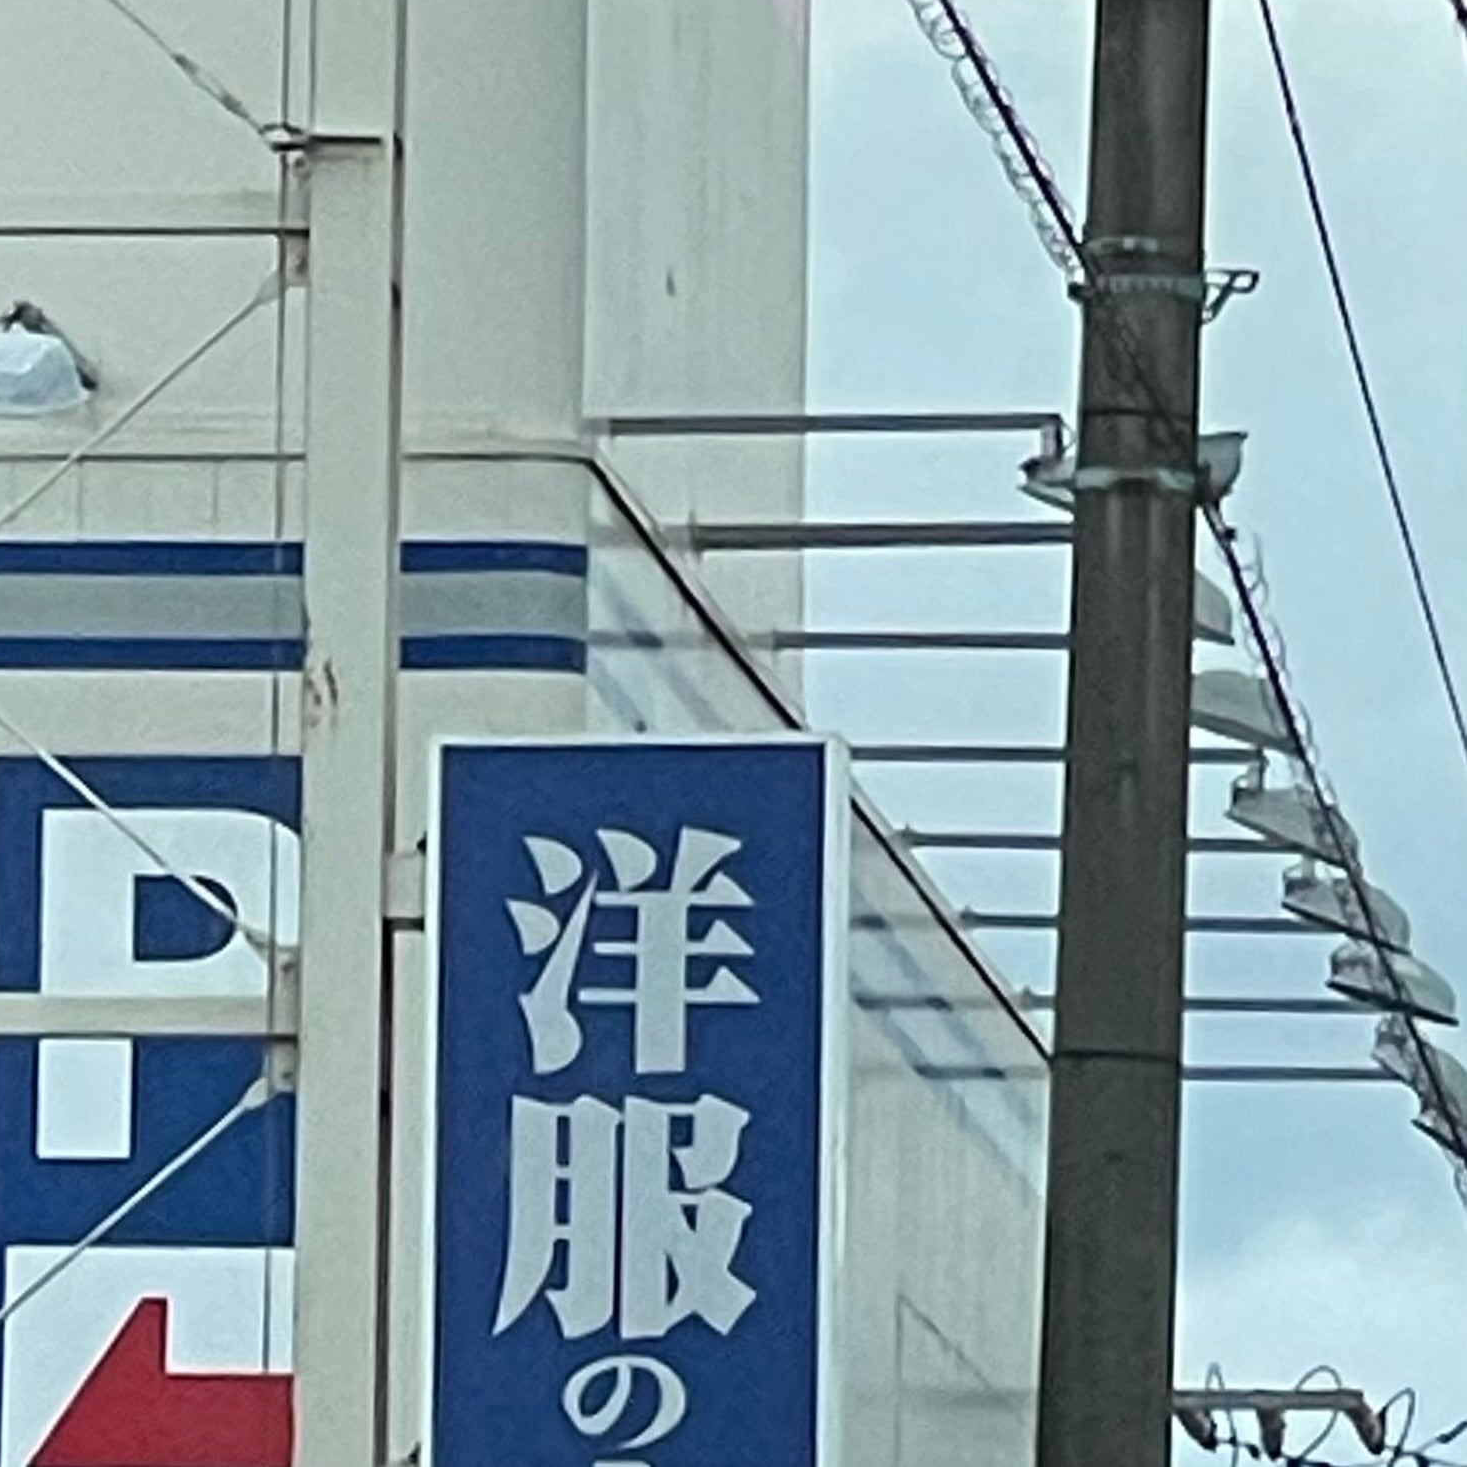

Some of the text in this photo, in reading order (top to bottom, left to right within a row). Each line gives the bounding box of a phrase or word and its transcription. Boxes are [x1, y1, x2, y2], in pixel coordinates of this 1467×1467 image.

[38, 808, 301, 1159] P
[492, 828, 761, 1467] 洋服の
